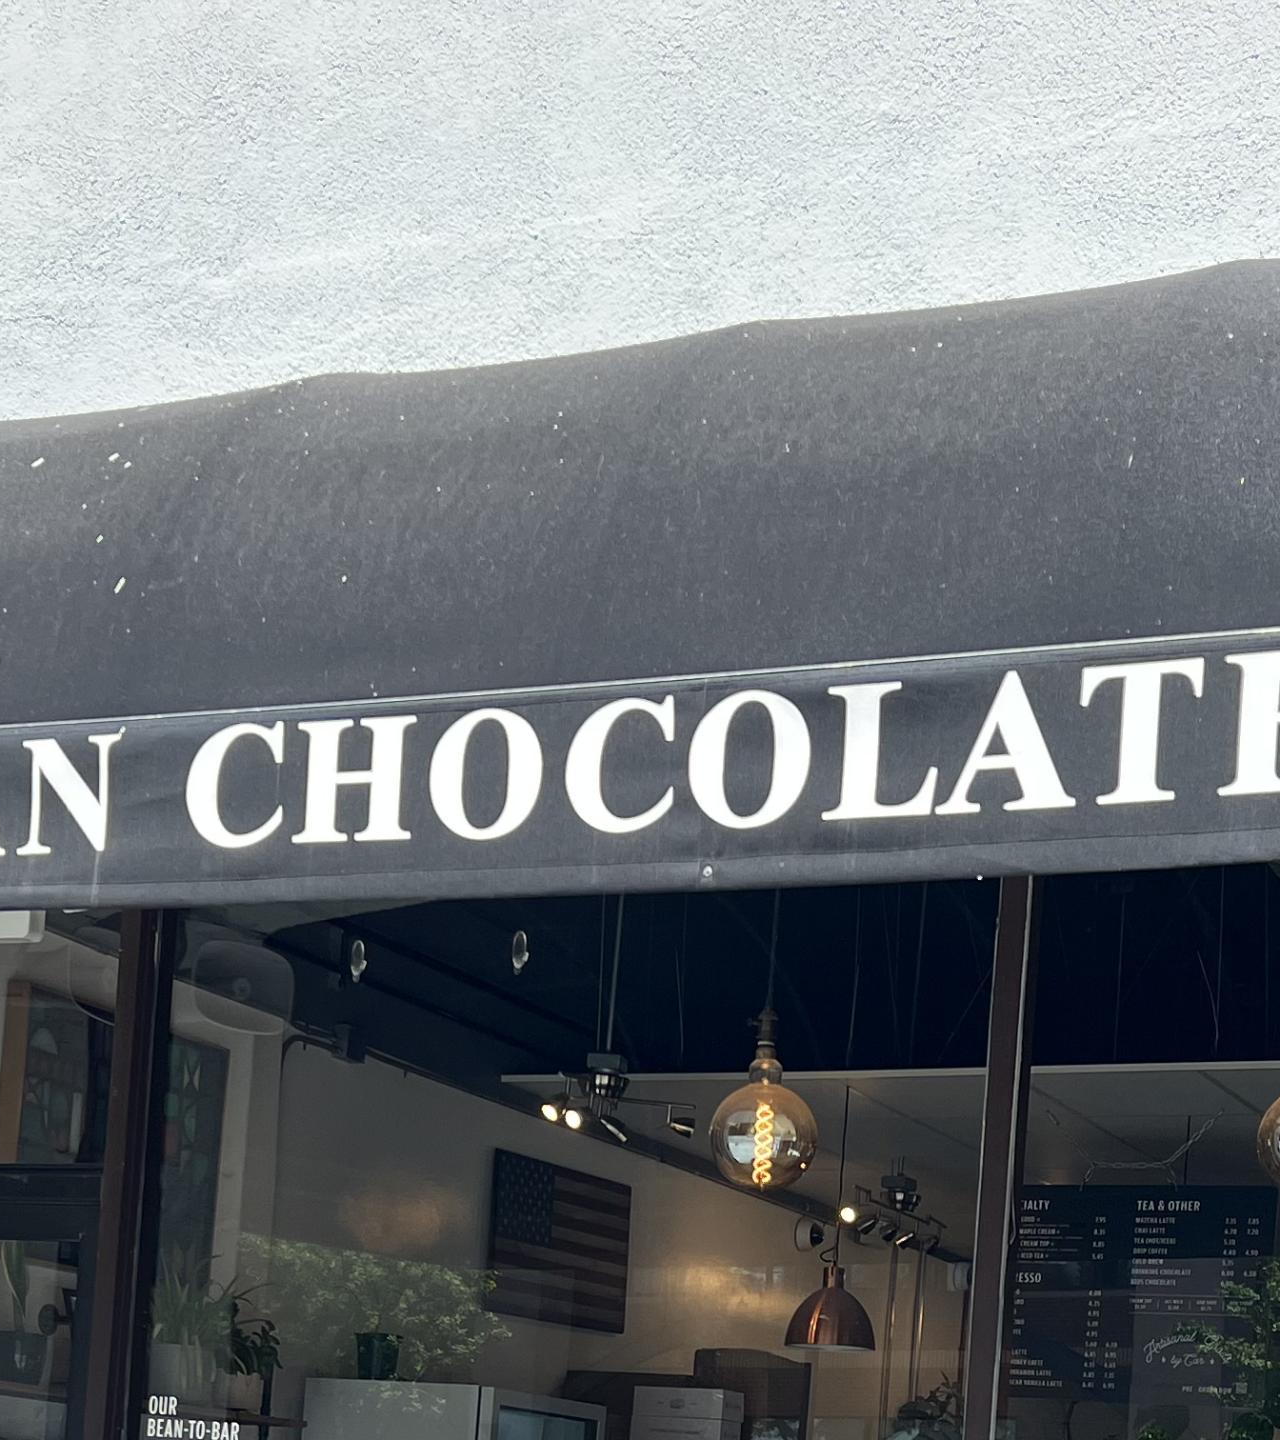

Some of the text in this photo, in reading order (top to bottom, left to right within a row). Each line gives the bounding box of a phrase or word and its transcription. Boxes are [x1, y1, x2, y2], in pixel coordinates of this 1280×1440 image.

[1136, 1200, 1201, 1212] TEA & OTHER
[1016, 1272, 1042, 1283] ESSO
[1143, 1331, 1197, 1363] Artisanal
[1170, 1355, 1183, 1369] by
[148, 1395, 178, 1416] OUR
